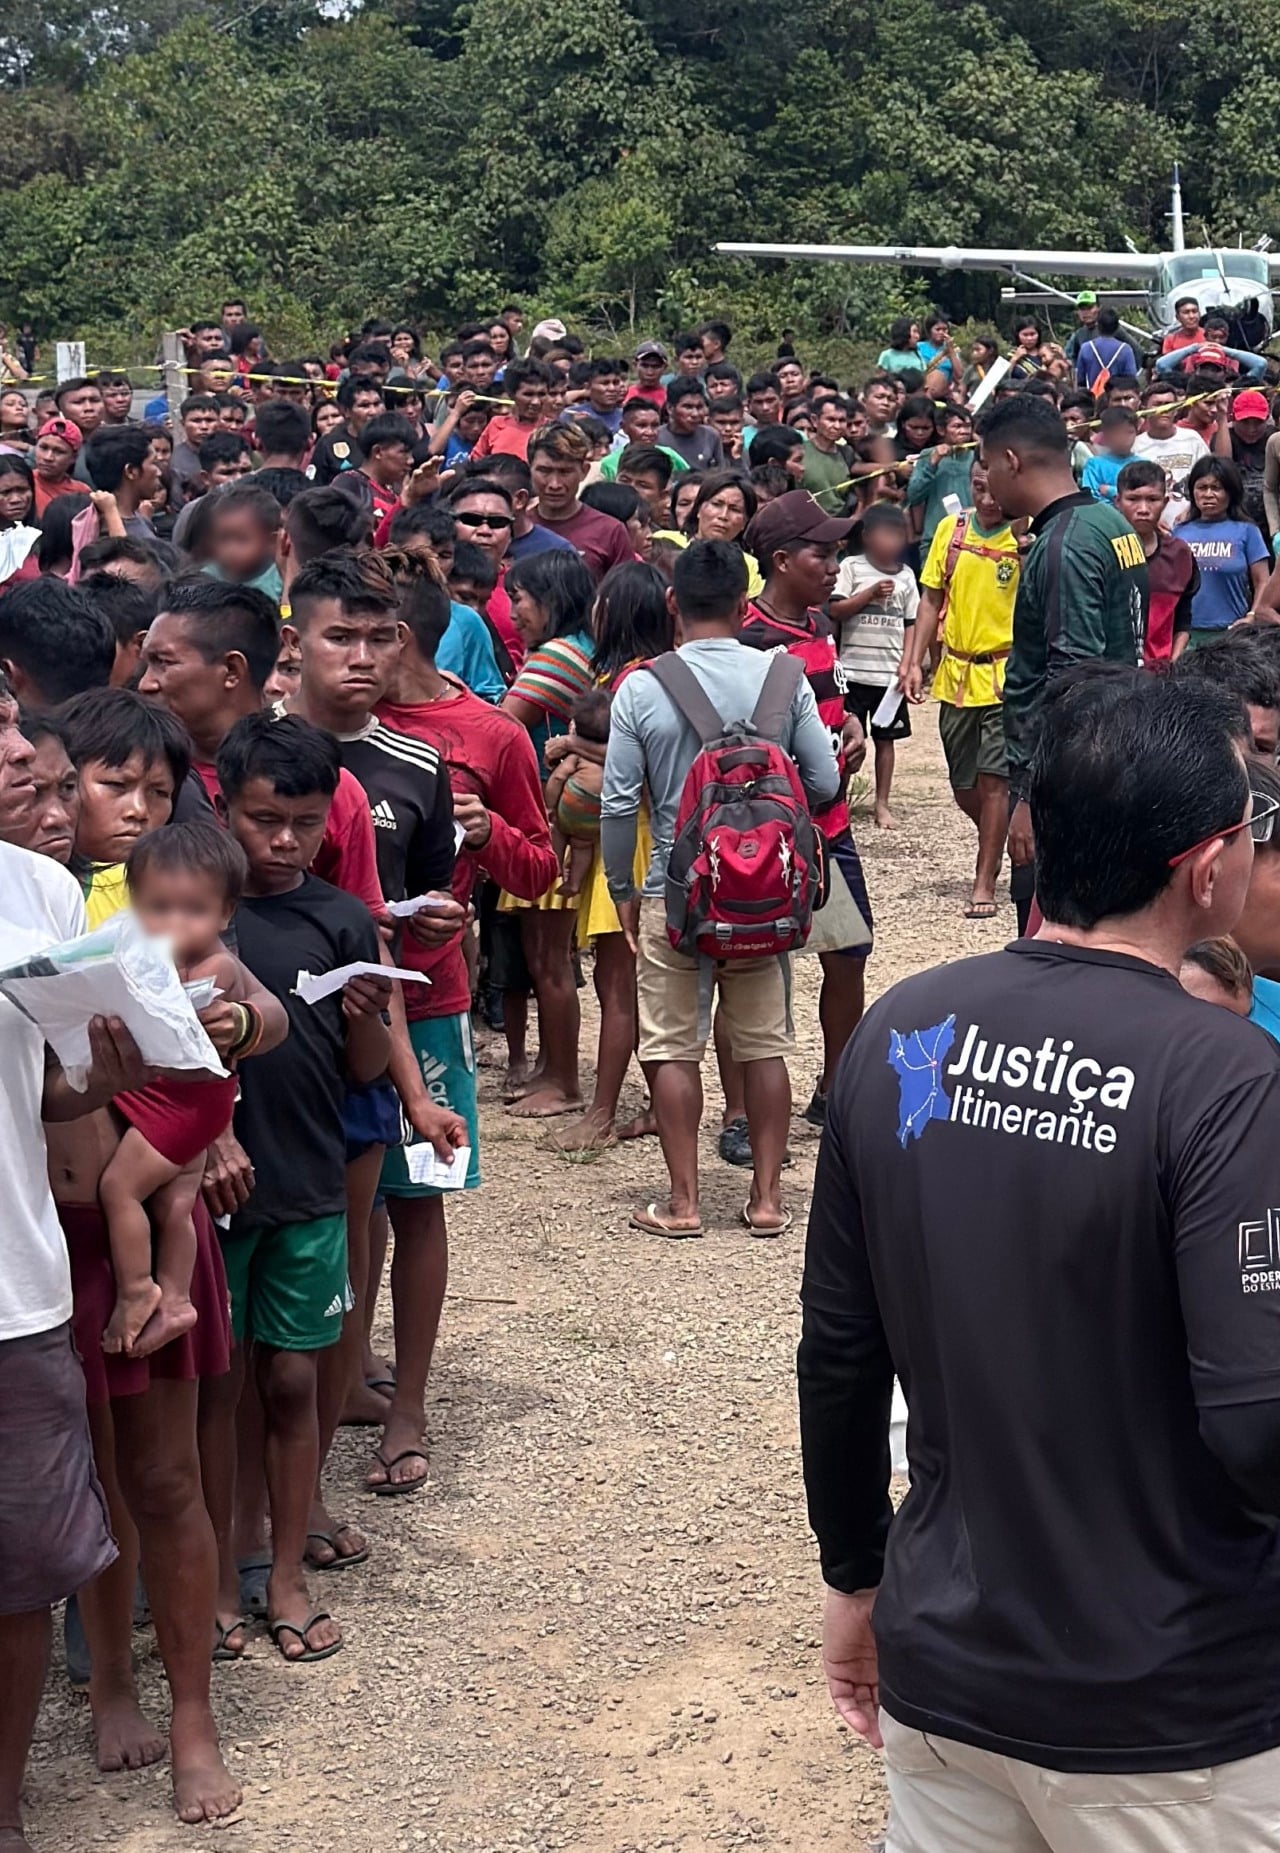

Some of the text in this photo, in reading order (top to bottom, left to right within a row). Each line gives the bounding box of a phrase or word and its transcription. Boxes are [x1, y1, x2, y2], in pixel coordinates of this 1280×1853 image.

[1189, 541, 1232, 558] EMIUM
[372, 817, 397, 830] didas
[947, 1024, 1136, 1113] Justiça
[951, 1085, 1117, 1153] Itinerante
[1243, 1284, 1258, 1293] DO
